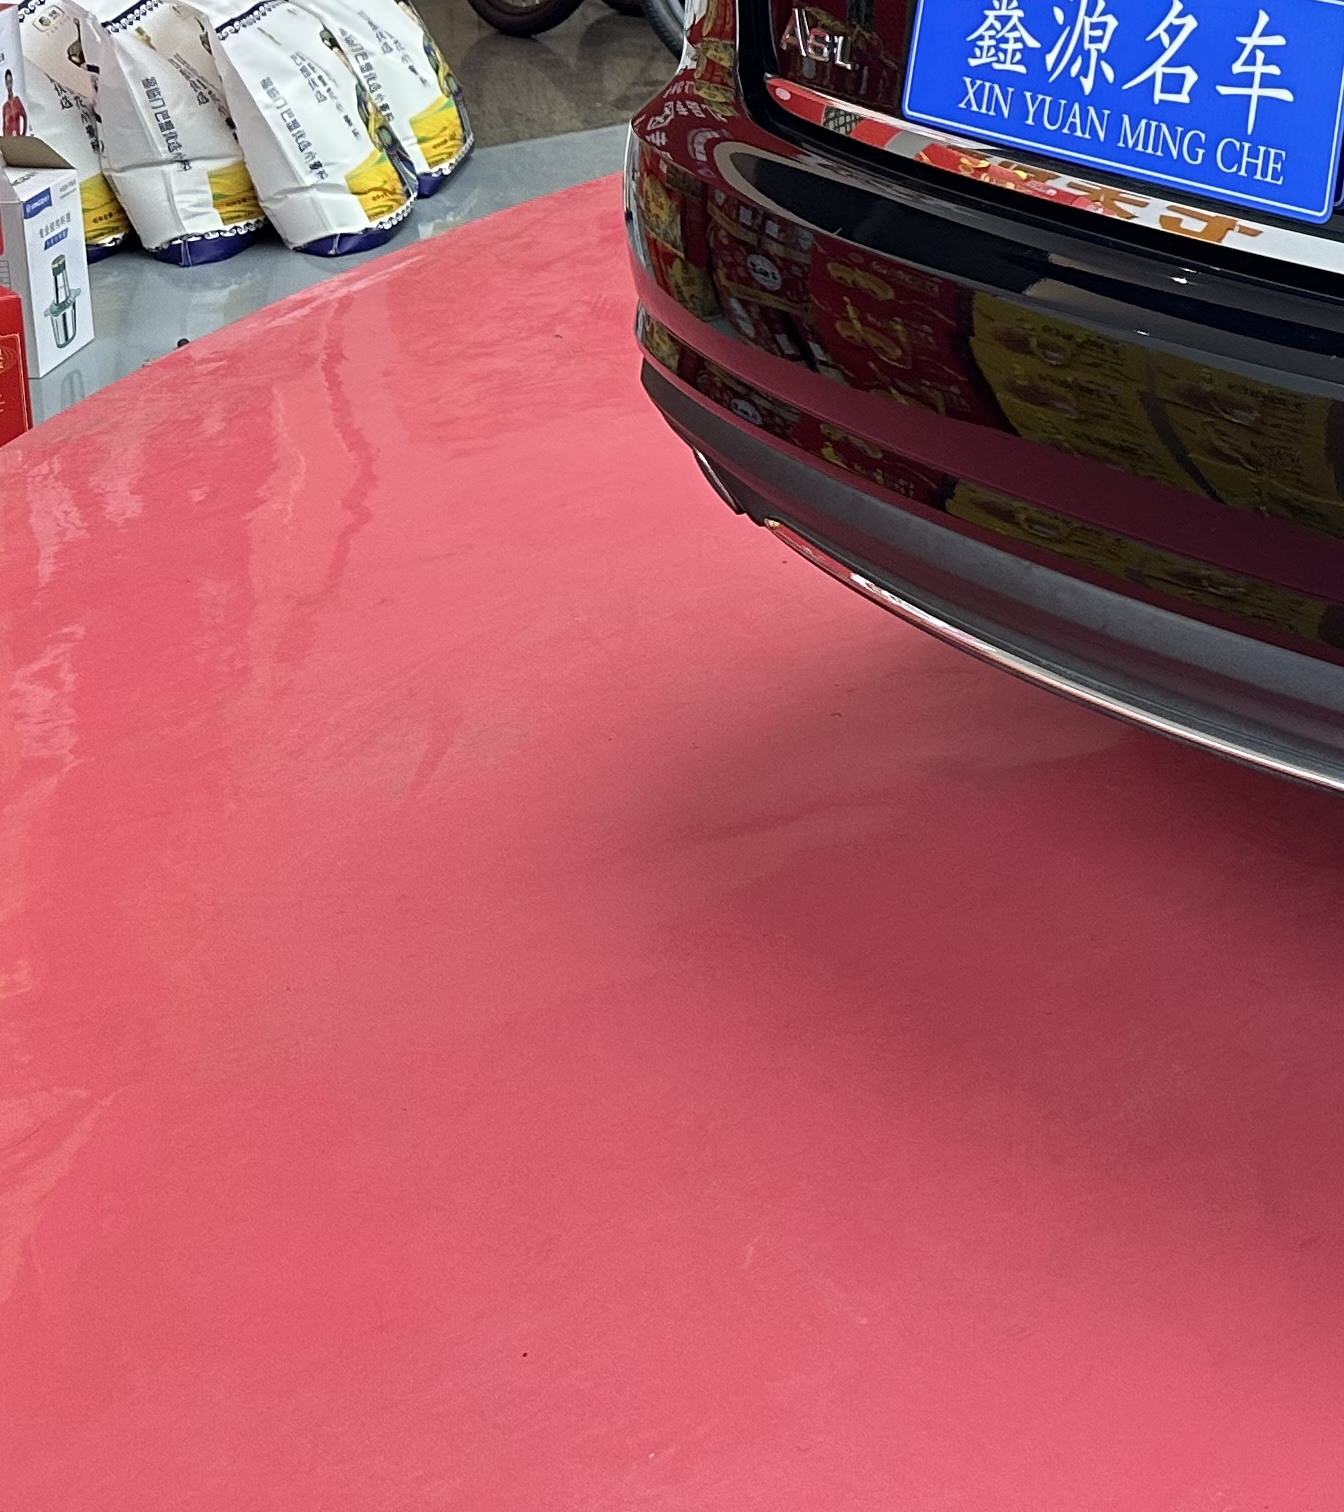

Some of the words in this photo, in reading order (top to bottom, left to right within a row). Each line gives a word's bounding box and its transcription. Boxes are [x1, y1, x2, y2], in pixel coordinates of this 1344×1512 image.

[779, 7, 852, 71] A6L
[958, 76, 1014, 118] XIN
[1024, 91, 1112, 140] YUAN
[1117, 112, 1206, 166] MING
[1216, 137, 1287, 186] CHE
